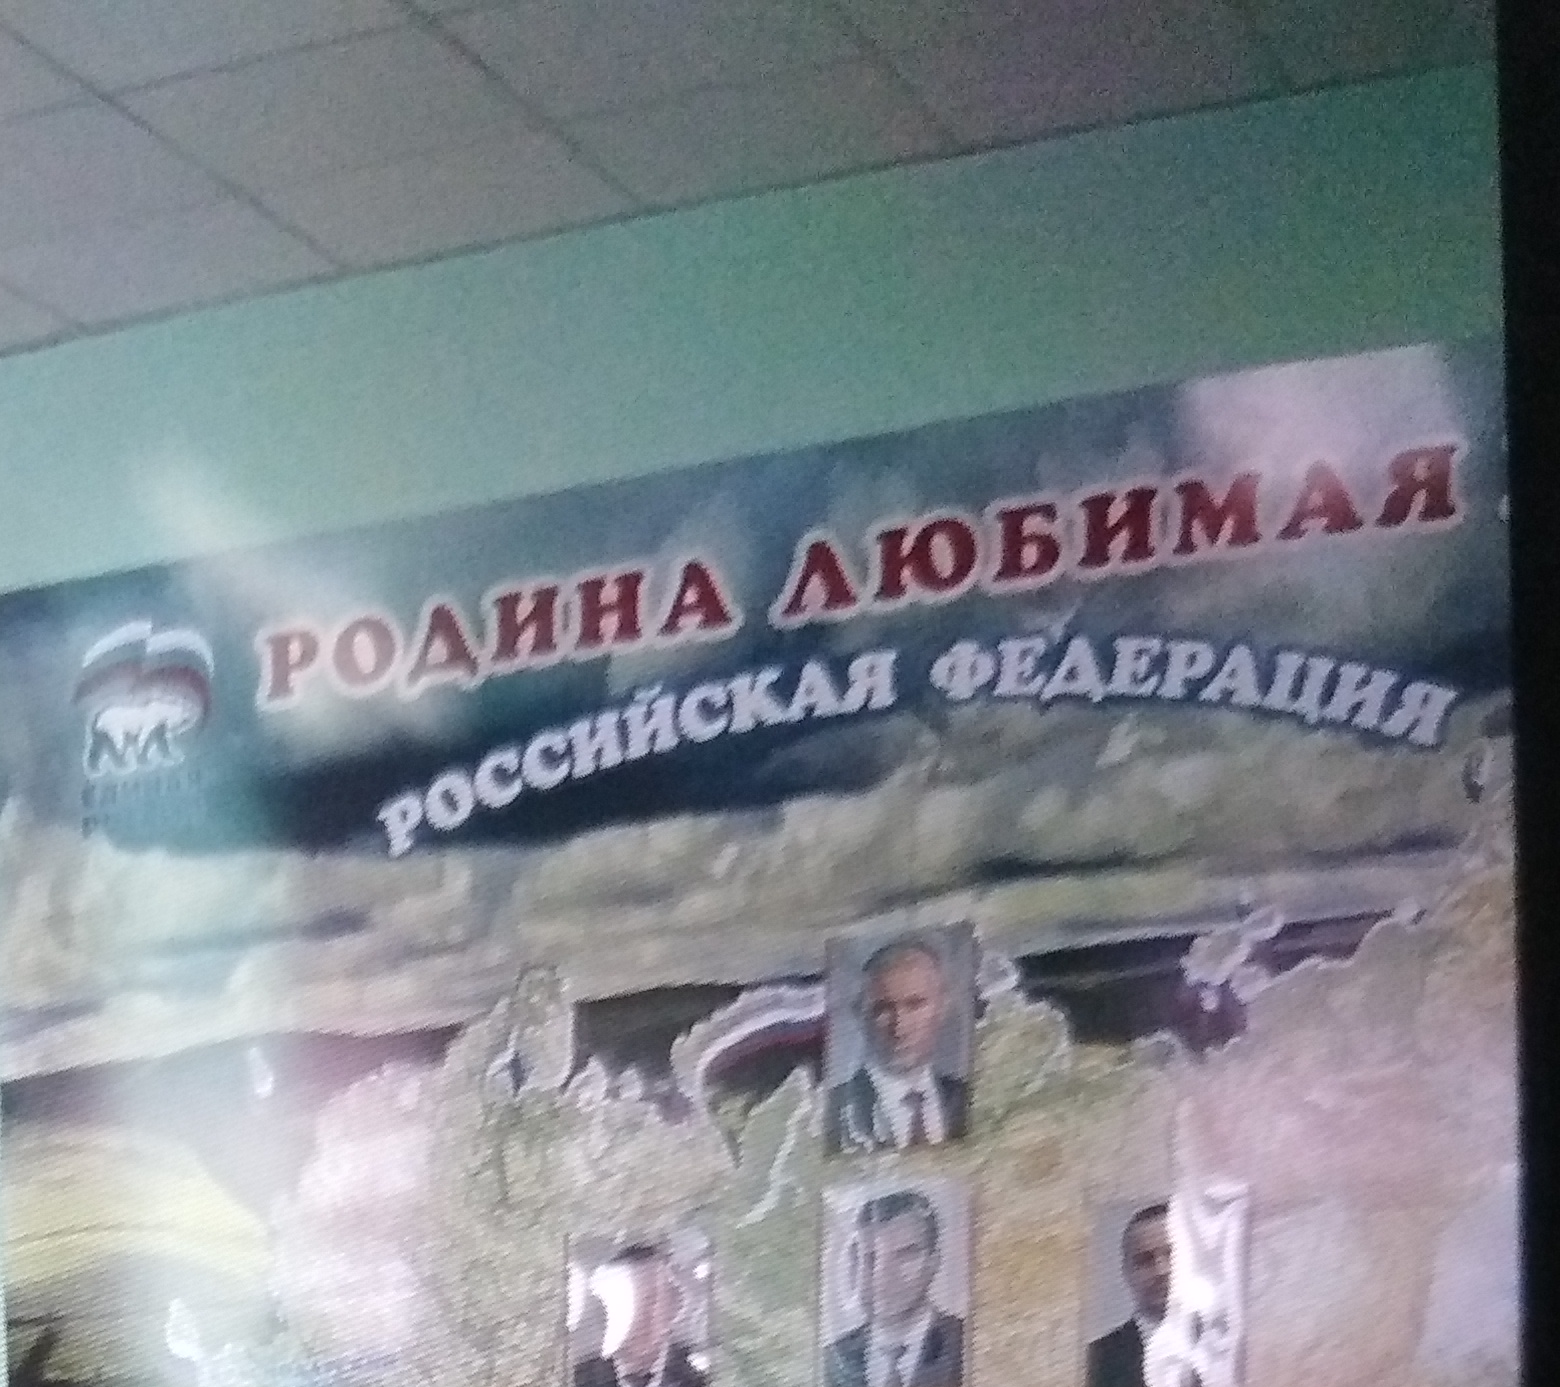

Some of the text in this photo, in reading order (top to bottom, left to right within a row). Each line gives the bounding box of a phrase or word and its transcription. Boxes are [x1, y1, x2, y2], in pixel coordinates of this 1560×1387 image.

[260, 442, 1461, 707] РОДИНА ЛЮБИМАЯ
[377, 635, 1459, 858] РОССИЙСКАЯ ФЕДЕРАЦИЯ
